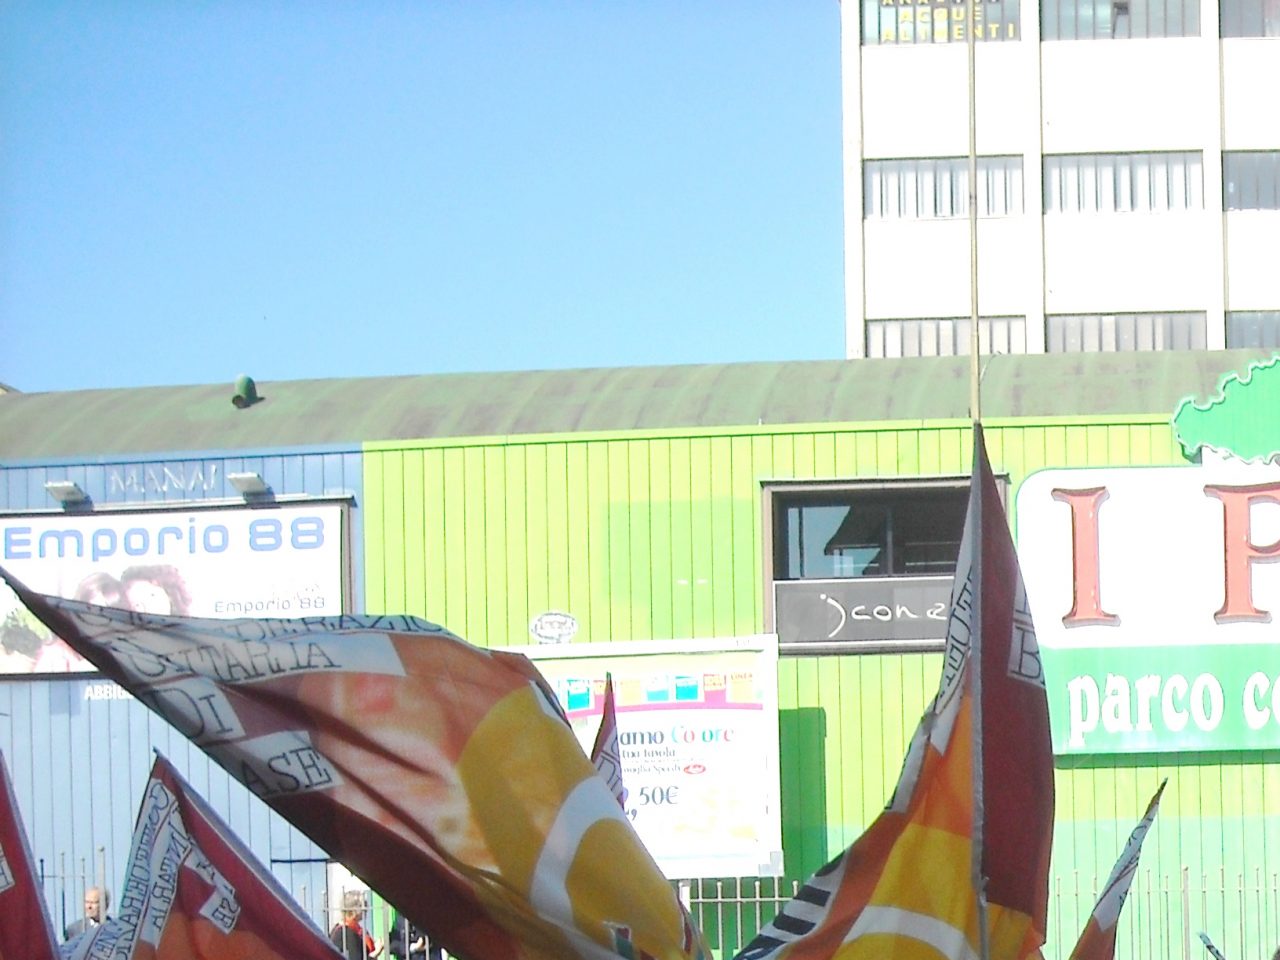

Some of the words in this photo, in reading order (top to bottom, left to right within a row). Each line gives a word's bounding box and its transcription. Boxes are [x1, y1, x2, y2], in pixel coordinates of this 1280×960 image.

[4, 517, 230, 562] Emporio
[249, 516, 325, 552] 88
[1051, 484, 1122, 629] I
[214, 597, 291, 614] Emporio
[1066, 668, 1226, 747] parco
